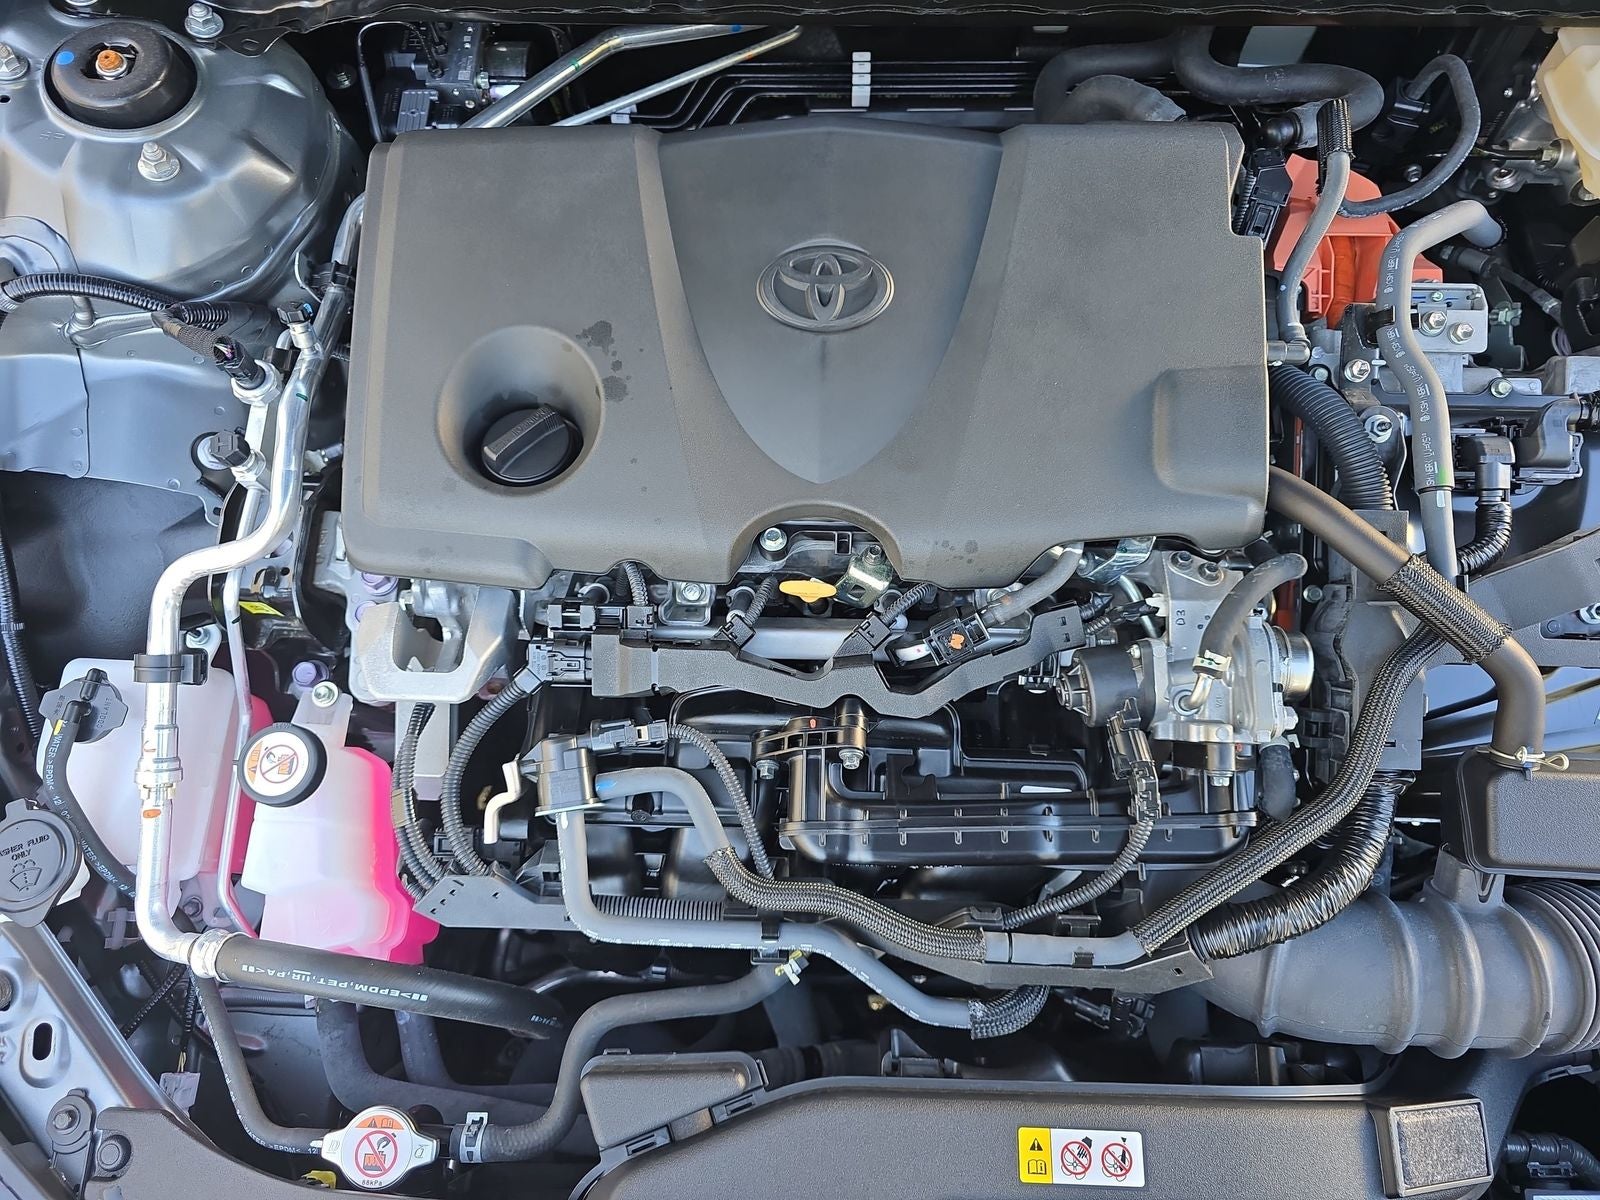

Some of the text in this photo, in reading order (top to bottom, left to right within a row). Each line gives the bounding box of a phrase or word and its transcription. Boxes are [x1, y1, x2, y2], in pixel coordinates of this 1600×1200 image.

[48, 733, 63, 758] WATER
[0, 833, 50, 857] ASHER FLUID
[11, 848, 32, 861] ONLY
